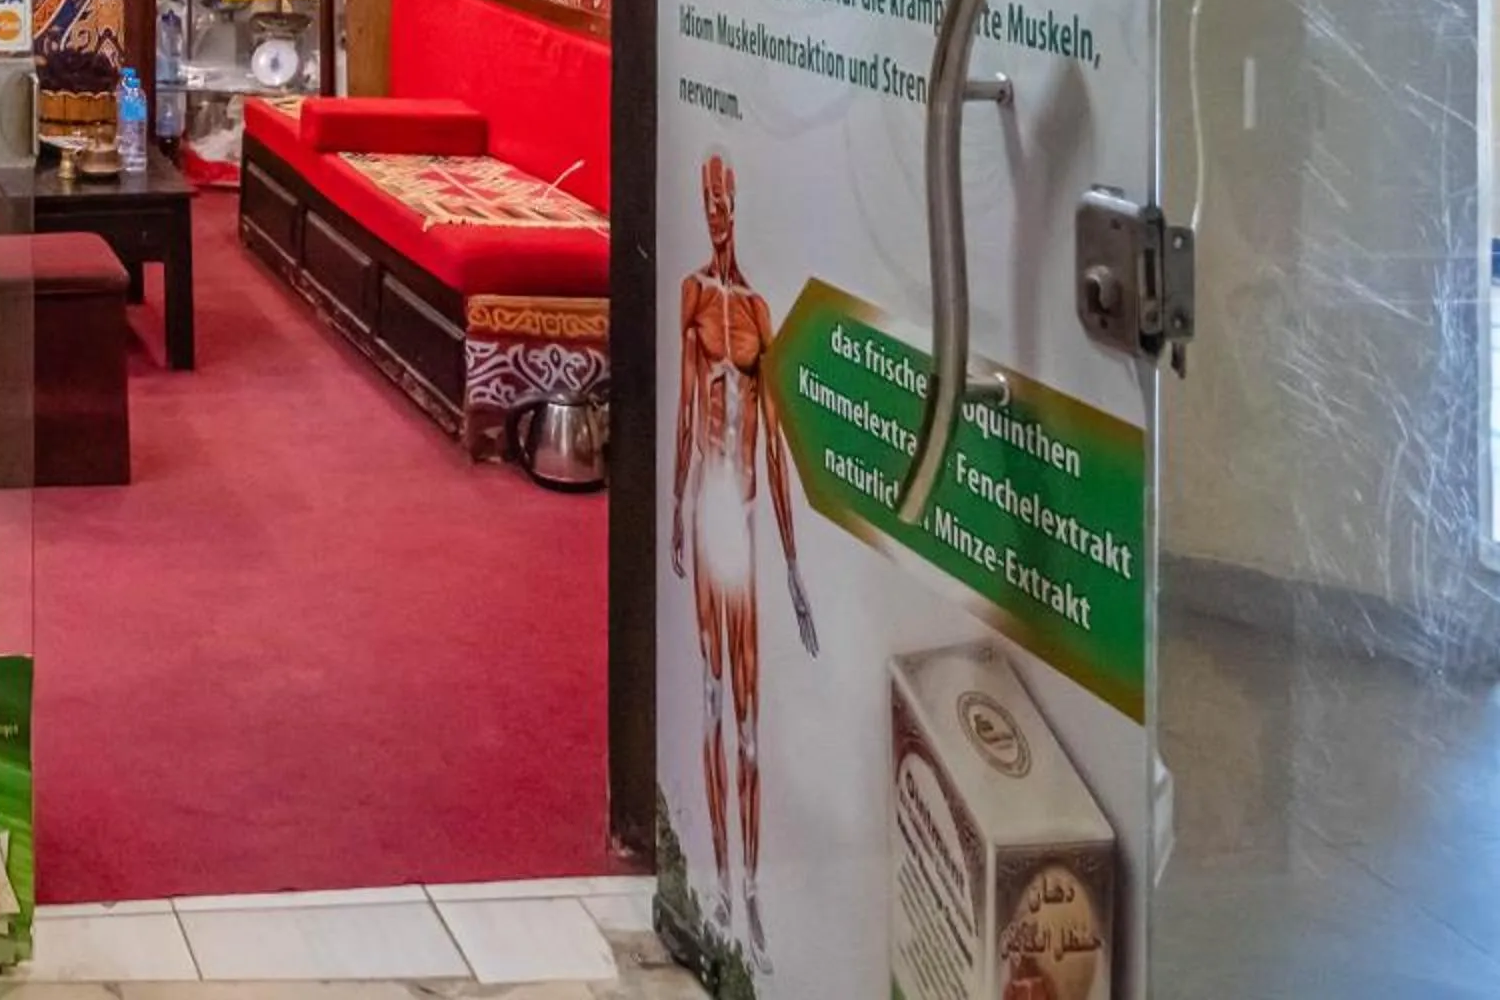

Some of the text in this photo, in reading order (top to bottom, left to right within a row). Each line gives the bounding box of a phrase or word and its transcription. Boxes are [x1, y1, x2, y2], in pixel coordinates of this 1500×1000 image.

[680, 6, 927, 105] Idiom Muskelkontraktion und Stren
[1007, 2, 1101, 69] Muskeln,
[679, 77, 743, 121] nervorum.
[831, 324, 928, 399] das frische
[799, 369, 1132, 579] Kümmelextra Fenchelextrakt
[934, 507, 1092, 630] Minze-Extrakt
